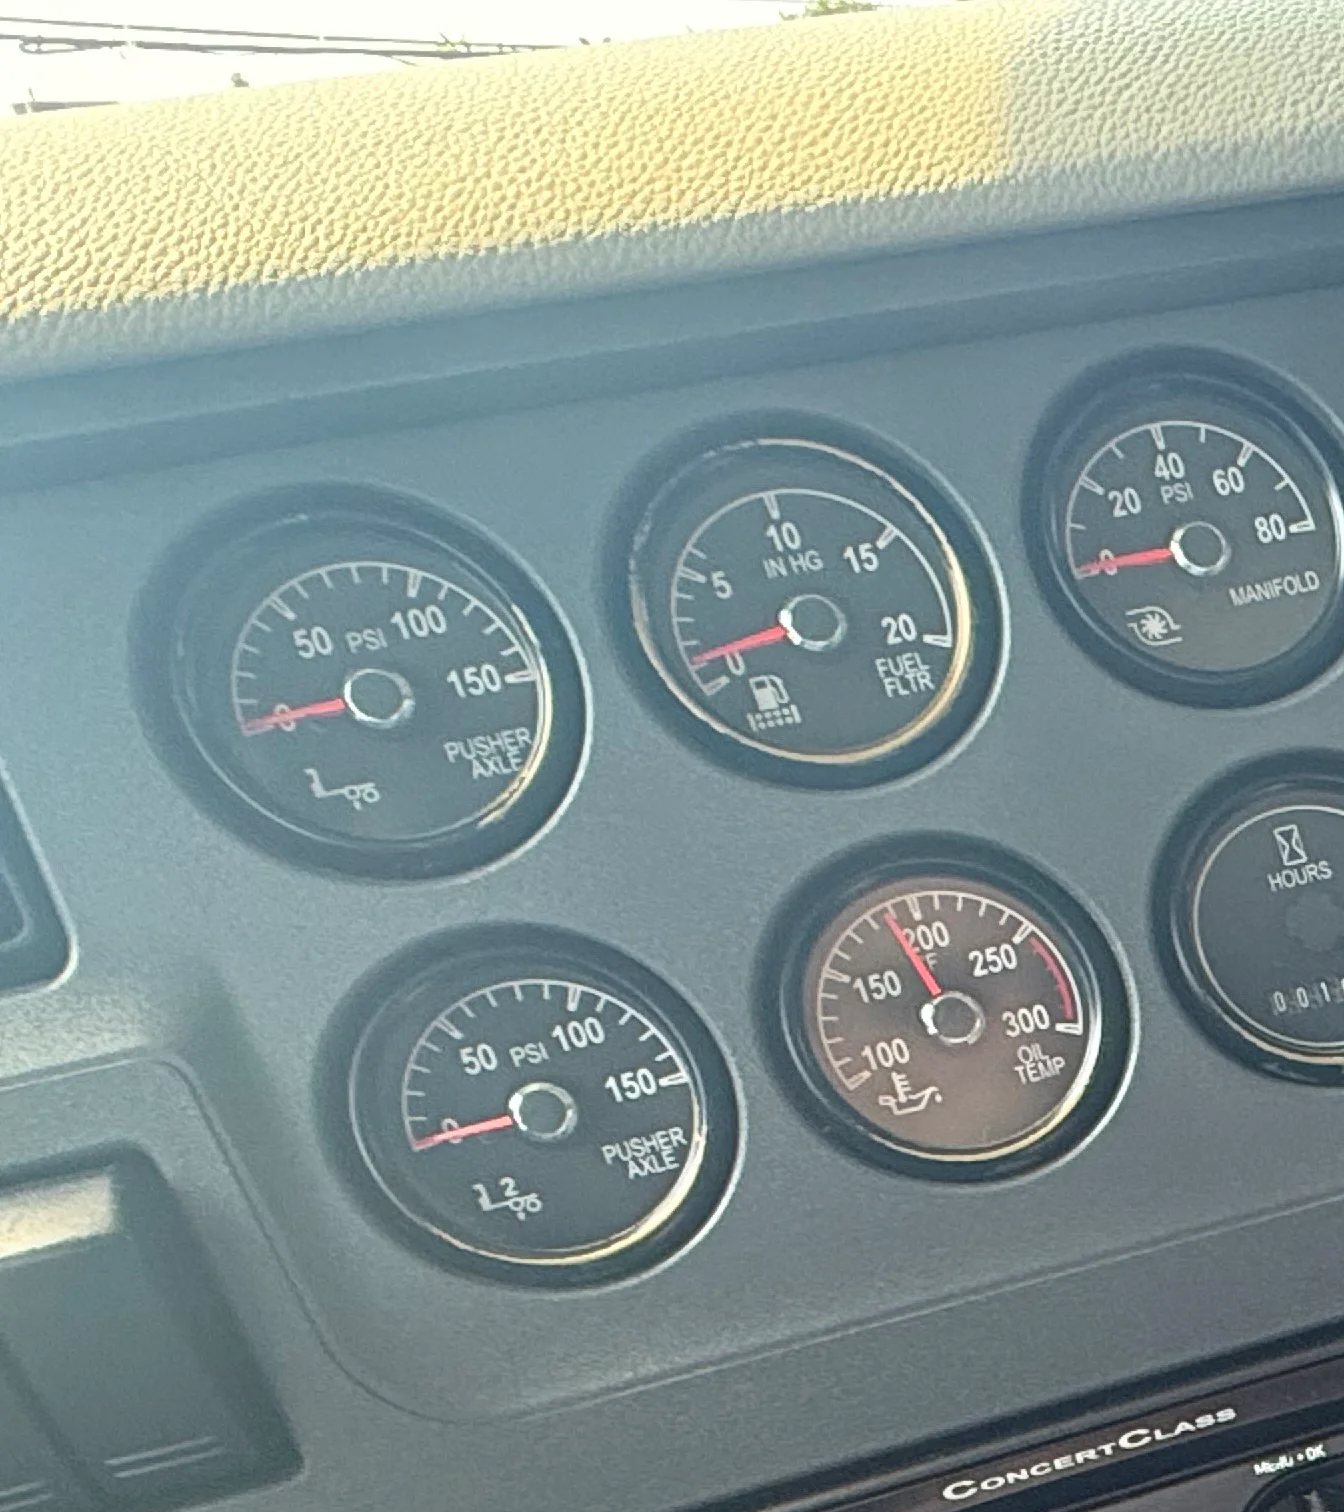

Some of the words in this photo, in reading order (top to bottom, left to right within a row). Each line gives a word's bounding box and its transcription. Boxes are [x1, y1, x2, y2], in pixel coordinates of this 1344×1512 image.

[1154, 451, 1185, 481] 40
[1212, 466, 1245, 496] 60
[1108, 487, 1142, 518] 20
[1161, 482, 1194, 505] PSI
[765, 521, 801, 552] 10
[1254, 513, 1287, 544] 80
[763, 556, 787, 579] IN
[790, 550, 824, 574] HG
[843, 543, 880, 574] 15
[711, 571, 734, 600] 5
[1229, 572, 1320, 607] MANIFOLD
[391, 606, 448, 641] 100
[881, 613, 917, 646] 20
[294, 628, 333, 660] 50
[346, 628, 388, 654] PSI
[447, 664, 502, 698] 150
[875, 651, 932, 680] FUEL
[881, 672, 936, 699] FLTR
[443, 727, 532, 763] PUSHER
[471, 750, 525, 780] AXLE
[1267, 860, 1334, 893] HOURS
[901, 919, 951, 954] 200
[968, 944, 1018, 978] 250
[852, 969, 903, 1005] 150
[551, 1015, 606, 1052] 100
[1002, 1003, 1050, 1038] 300
[459, 1042, 499, 1077] 50
[509, 1041, 549, 1069] PSI
[861, 1037, 911, 1072] 100
[1016, 1043, 1050, 1064] OIL
[604, 1067, 658, 1103] 150
[1013, 1057, 1066, 1085] TEMP
[601, 1125, 687, 1166] PUSHER
[627, 1149, 680, 1180] AXLE
